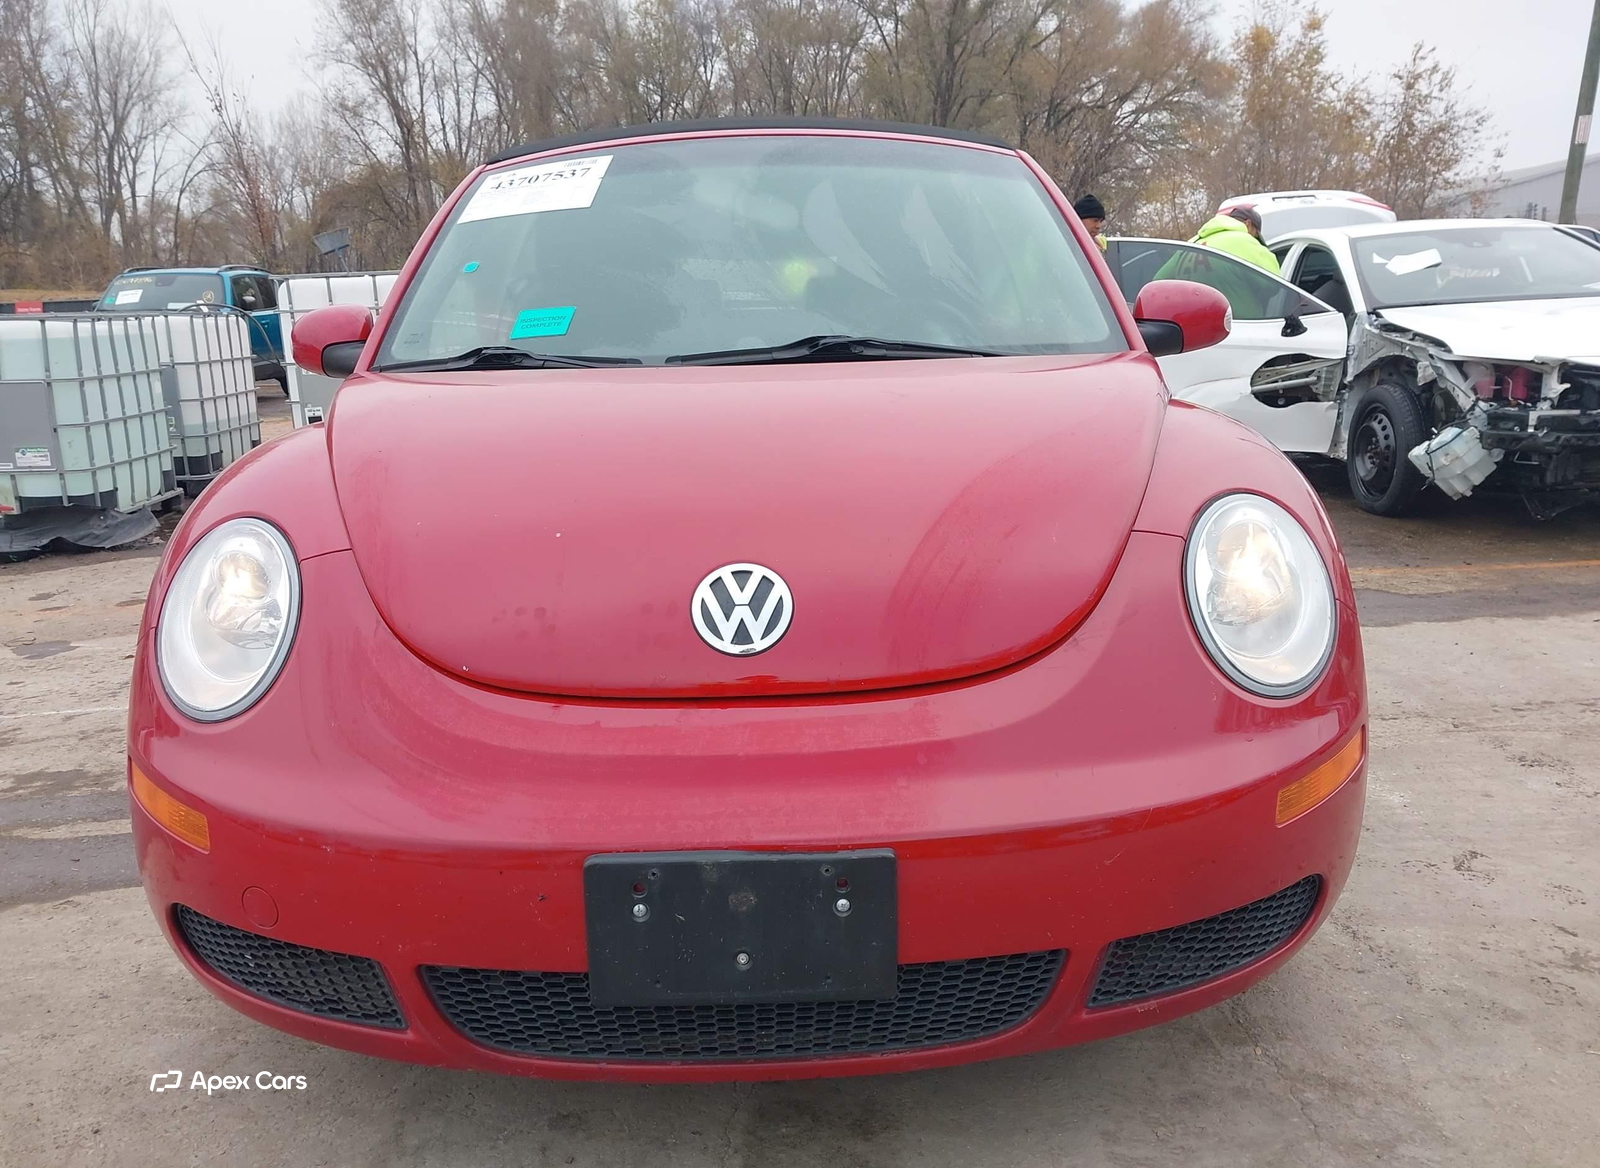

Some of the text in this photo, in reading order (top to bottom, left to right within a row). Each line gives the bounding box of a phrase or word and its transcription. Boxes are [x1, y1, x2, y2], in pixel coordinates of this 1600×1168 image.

[491, 167, 592, 190] 43707537
[520, 315, 567, 324] INSPECTION
[521, 321, 562, 330] COMPLETE
[693, 565, 792, 653] VW
